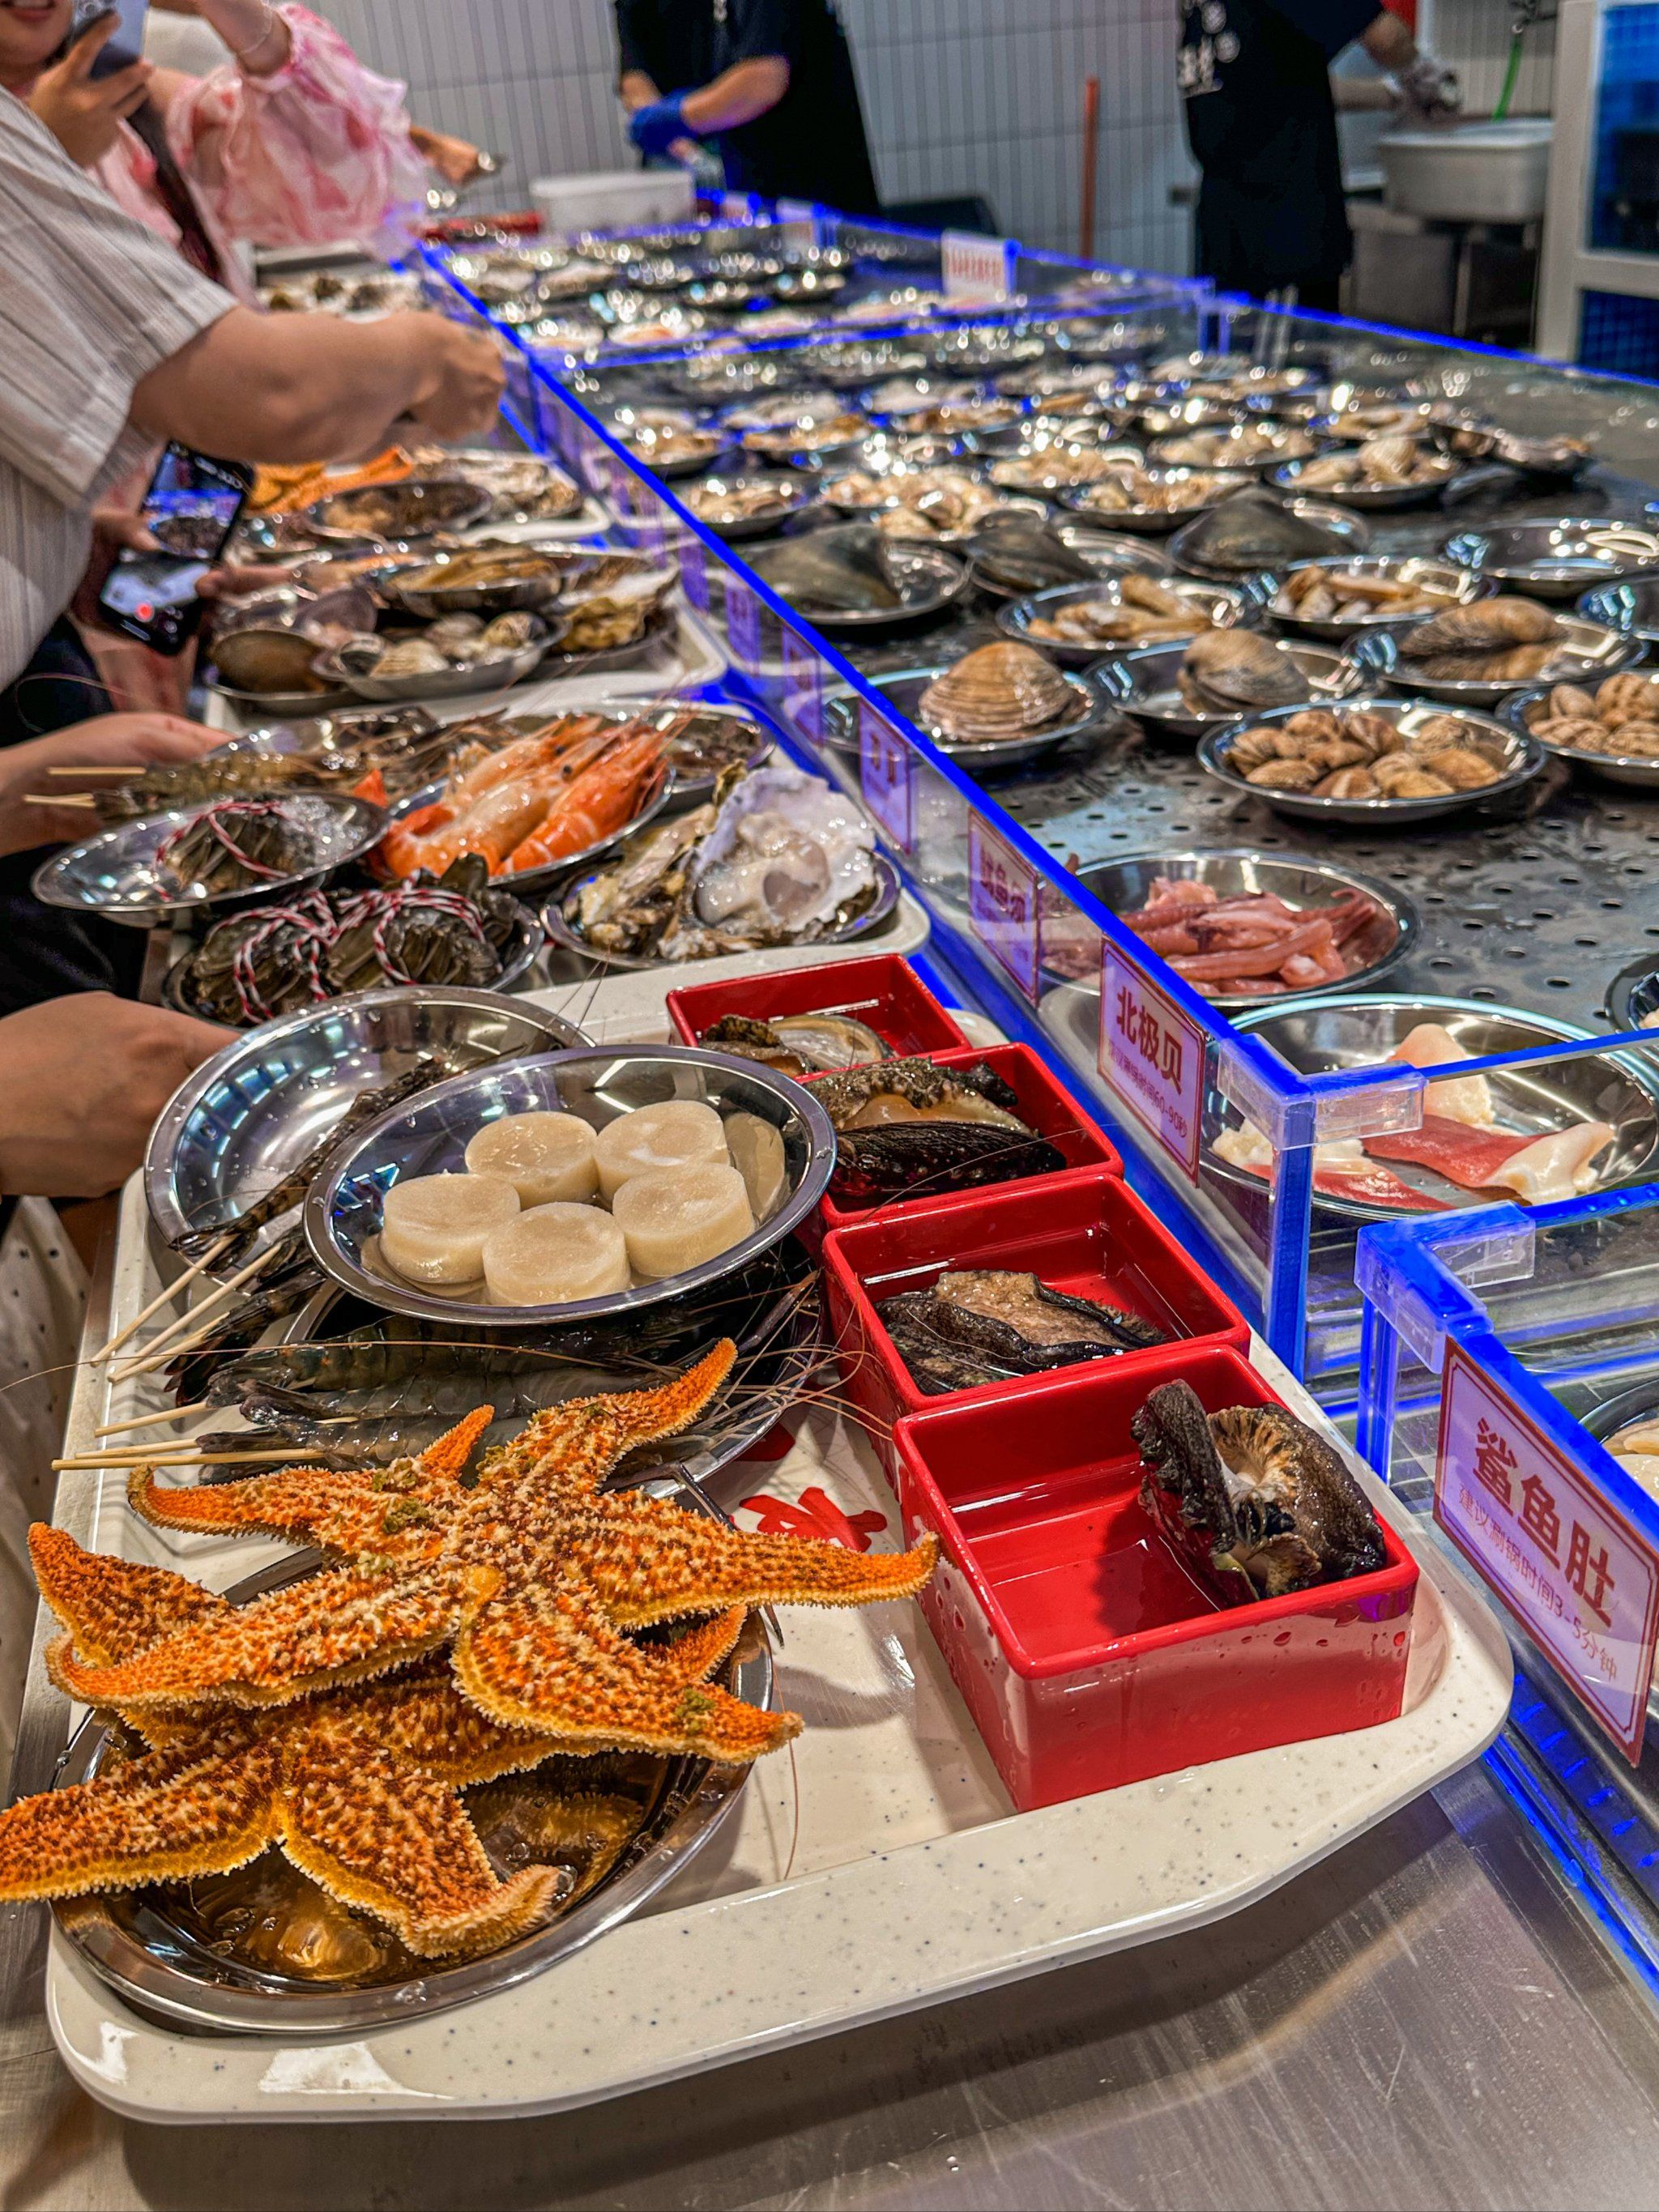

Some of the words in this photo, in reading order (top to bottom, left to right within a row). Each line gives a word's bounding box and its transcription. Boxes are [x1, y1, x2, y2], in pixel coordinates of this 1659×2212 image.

[1116, 986, 1183, 1095] 北极贝
[1459, 1482, 1618, 1682] 建议涮锅时间3-5分钟
[1473, 1417, 1616, 1628] 鲨鱼肚
